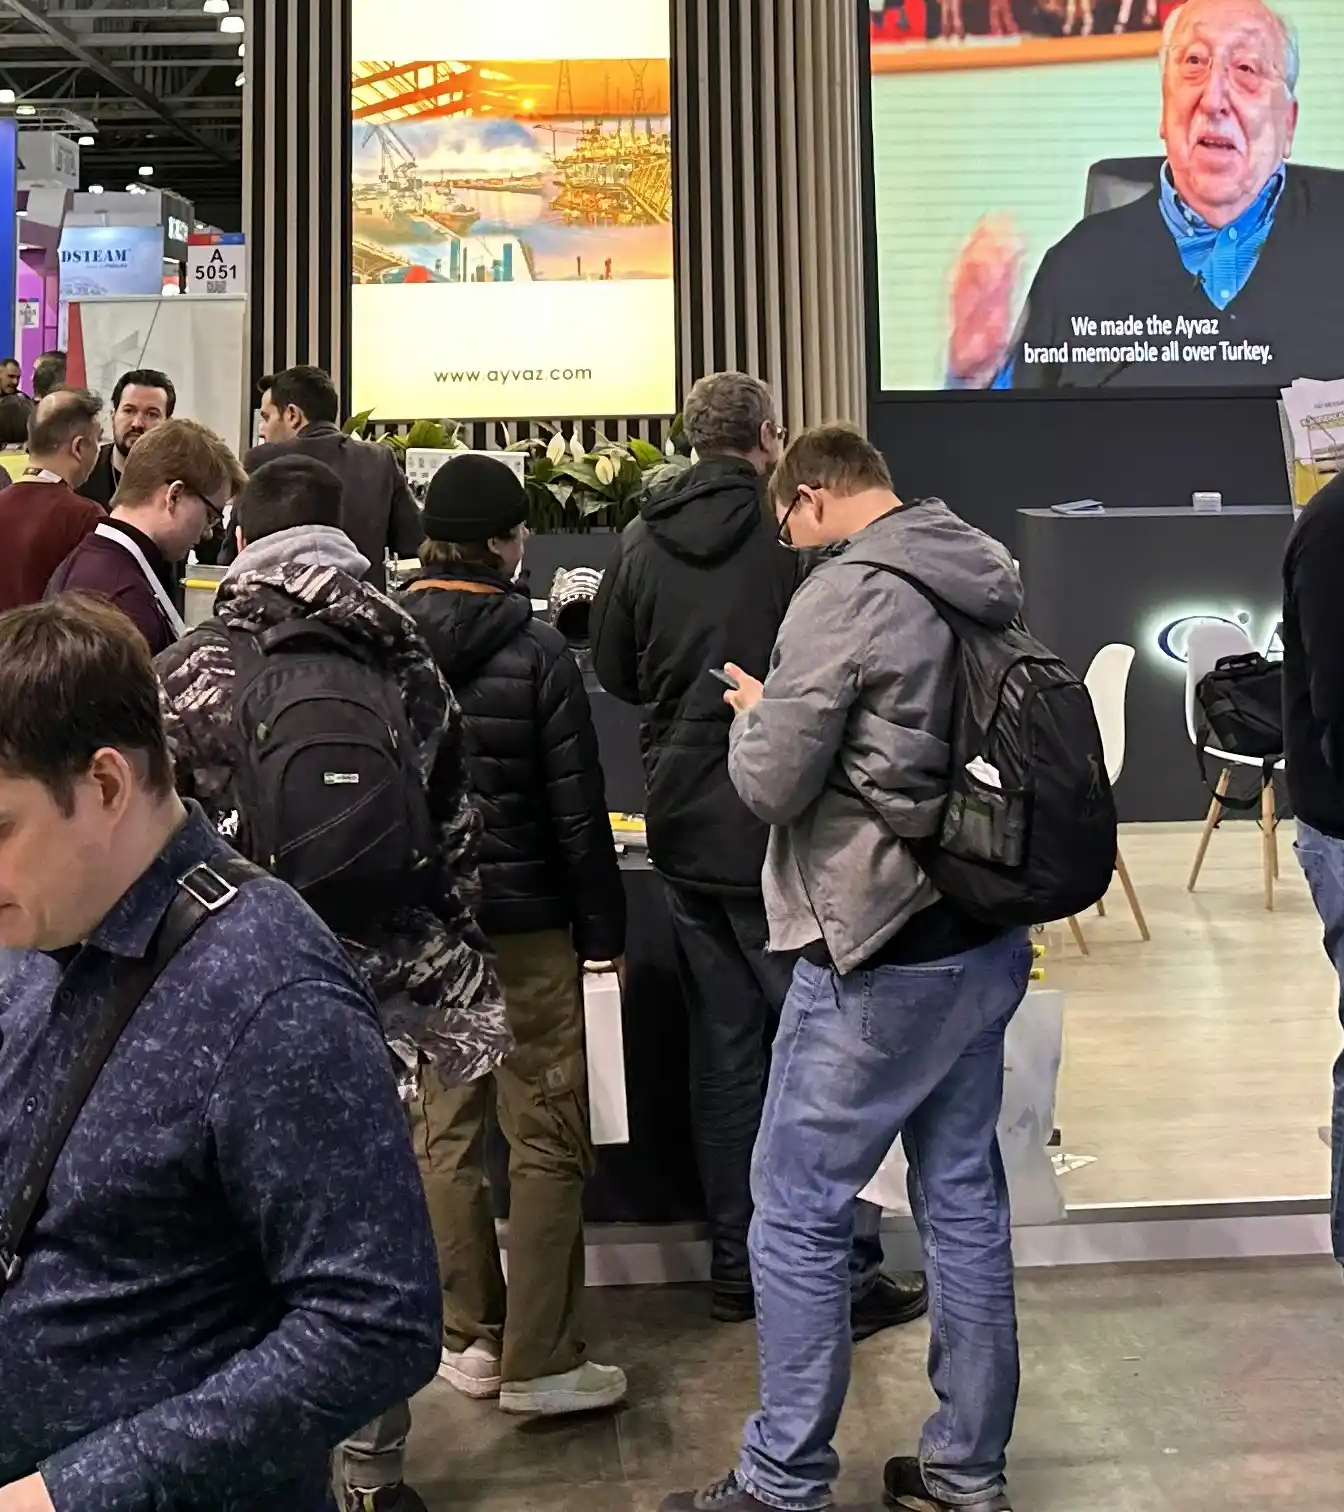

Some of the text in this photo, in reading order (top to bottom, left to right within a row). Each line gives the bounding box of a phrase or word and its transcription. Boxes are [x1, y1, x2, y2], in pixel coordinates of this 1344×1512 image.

[211, 248, 224, 264] A
[195, 264, 237, 280] 5051
[1071, 314, 1220, 339] We made the Ayvaz
[1023, 339, 1274, 365] brand memorable all over Turkey.
[433, 368, 593, 386] www.ayvaz.com
